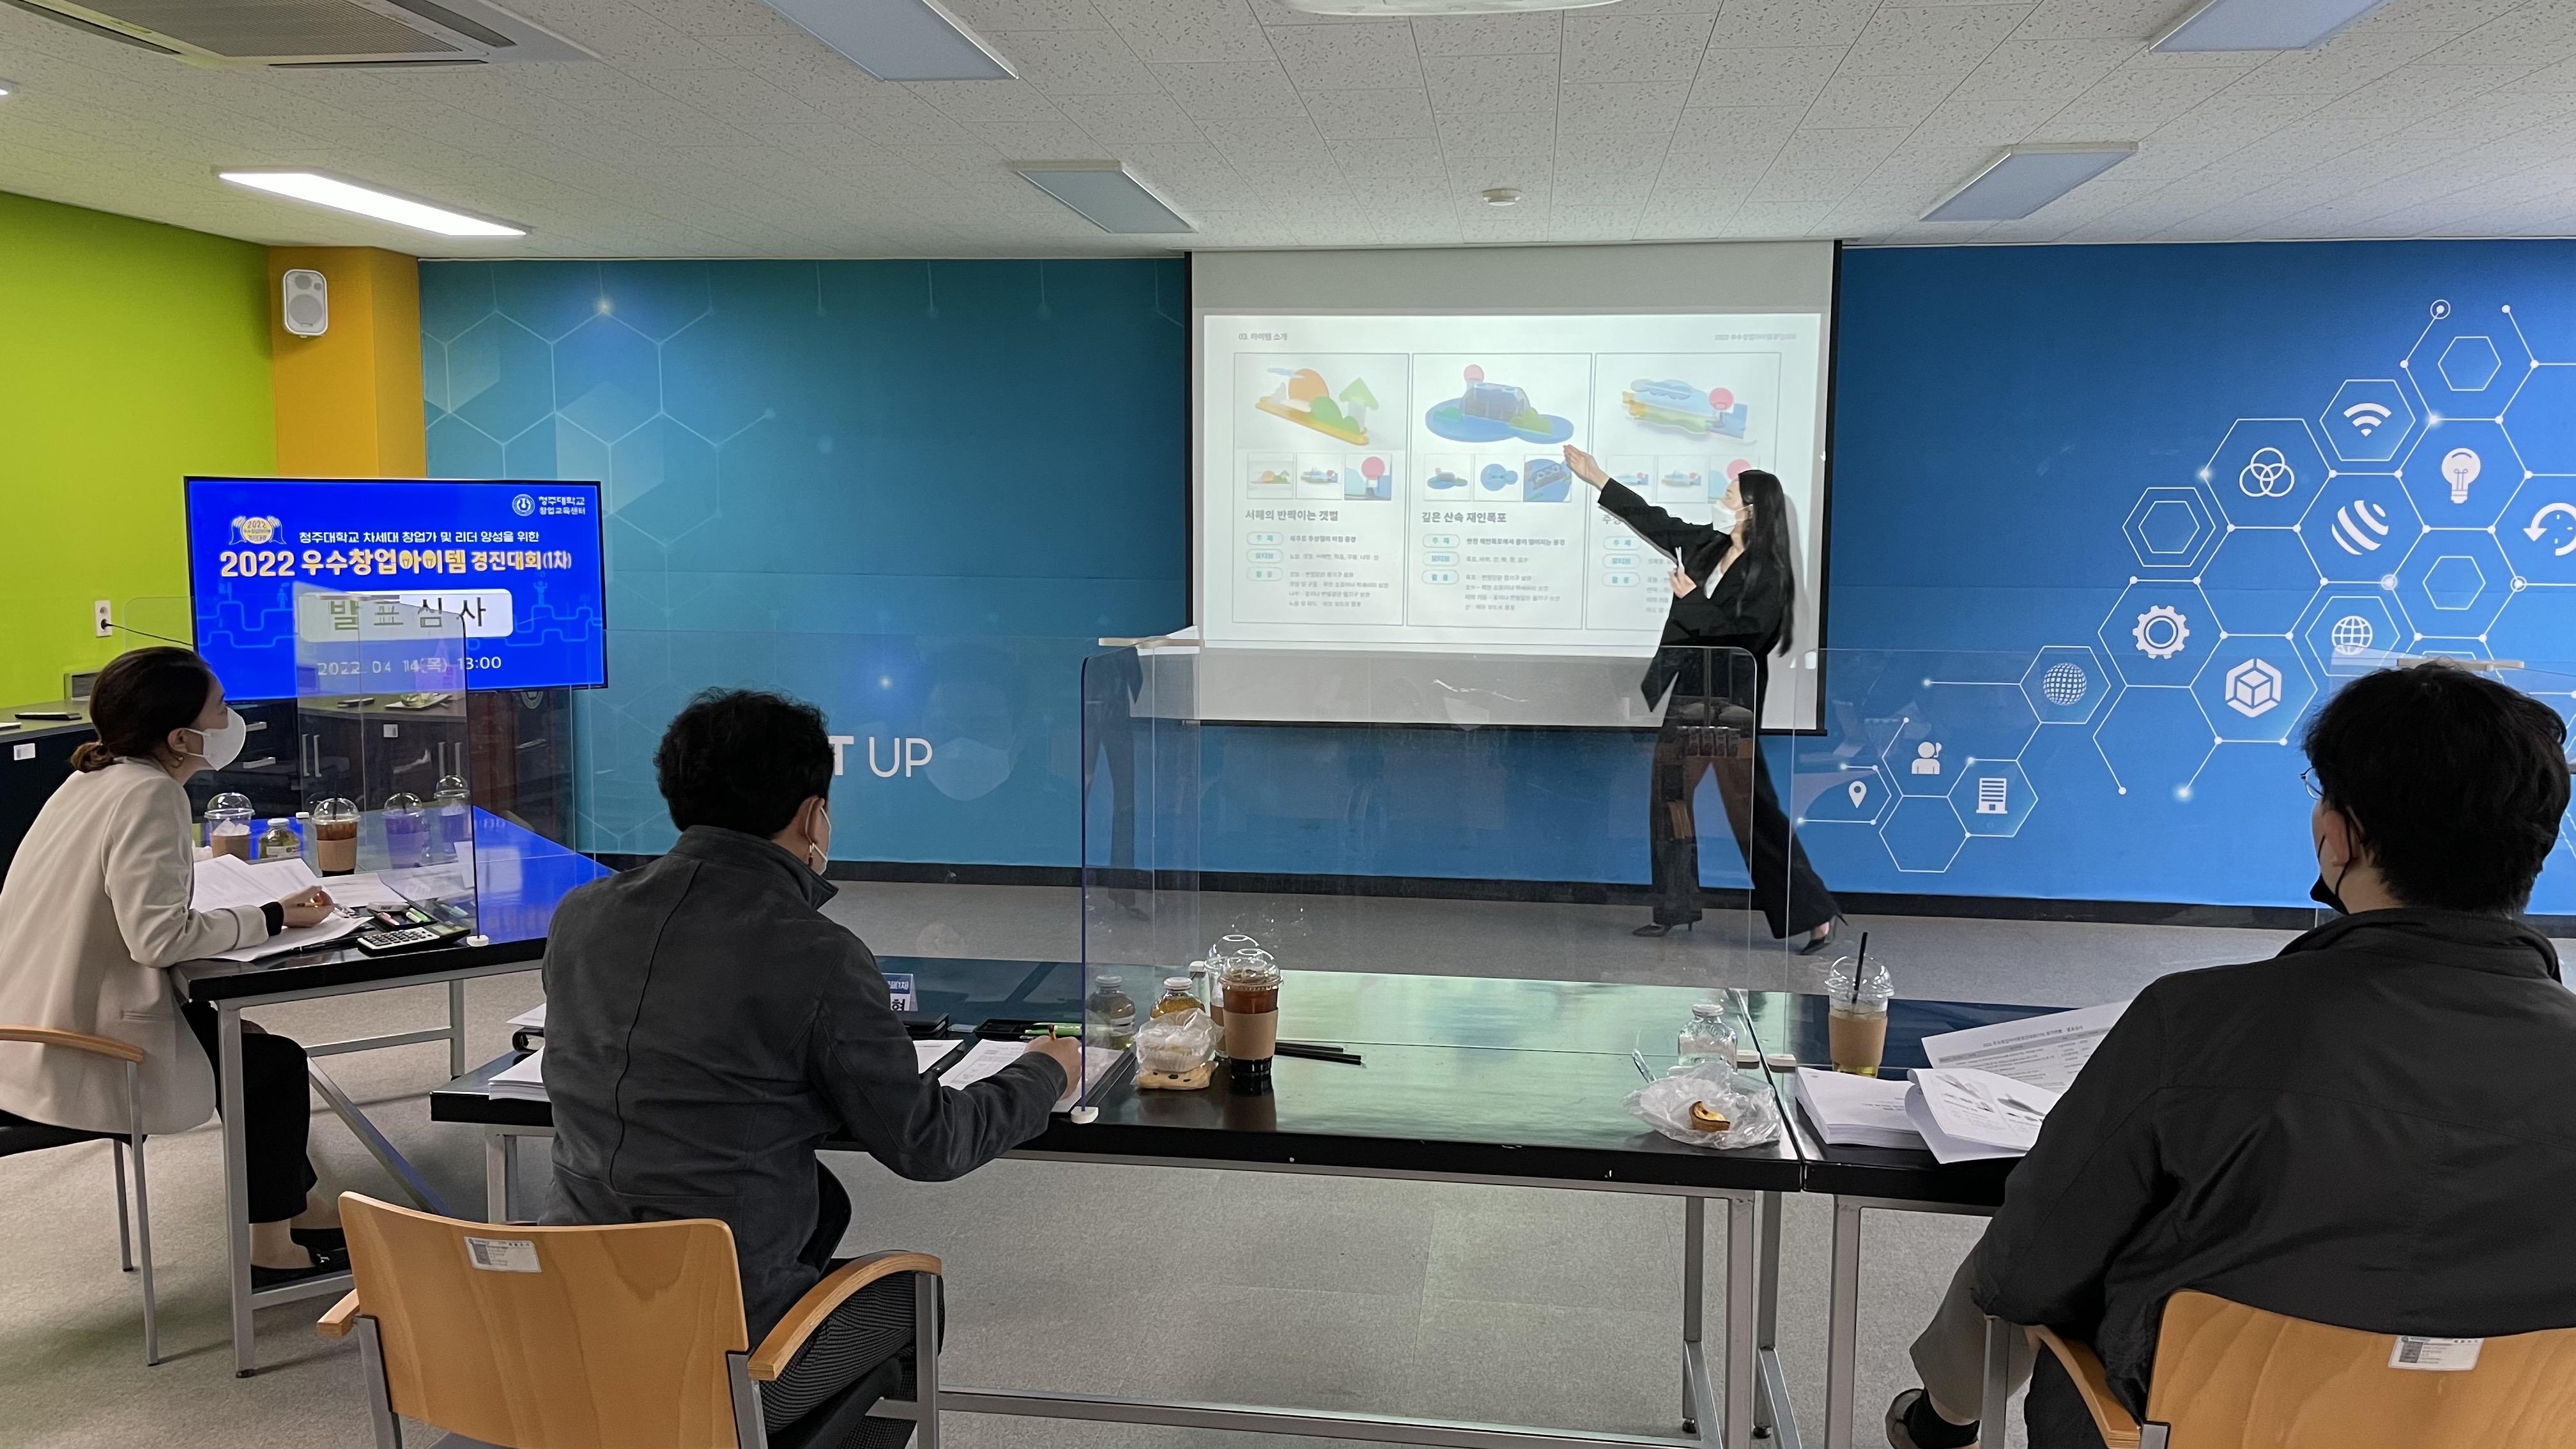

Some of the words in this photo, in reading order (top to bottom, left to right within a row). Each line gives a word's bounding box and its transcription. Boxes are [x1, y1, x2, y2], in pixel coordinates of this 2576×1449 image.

[538, 496, 585, 505] 청주대학교
[539, 507, 586, 515] 창업교육센터
[1245, 510, 1274, 520] 서해의
[1277, 510, 1316, 521] 반짝이는
[1319, 510, 1338, 521] 갯벌
[1422, 512, 1441, 523] 깊은
[1444, 512, 1464, 523] 산속
[1466, 512, 1506, 523] 재인폭포
[248, 521, 267, 529] 2022
[299, 531, 359, 544] 청주대학교
[363, 531, 399, 544] 차세대
[402, 531, 437, 543] 창업가
[440, 532, 452, 543] 및
[456, 531, 477, 542] 리더
[480, 531, 514, 543] 양성을
[517, 531, 540, 542] 위한
[220, 551, 296, 578] 2022
[302, 548, 467, 576] 우수창업아이템
[471, 550, 572, 572] 경진대회(1차)
[457, 656, 502, 670] 13:00
[869, 737, 933, 778] UP
